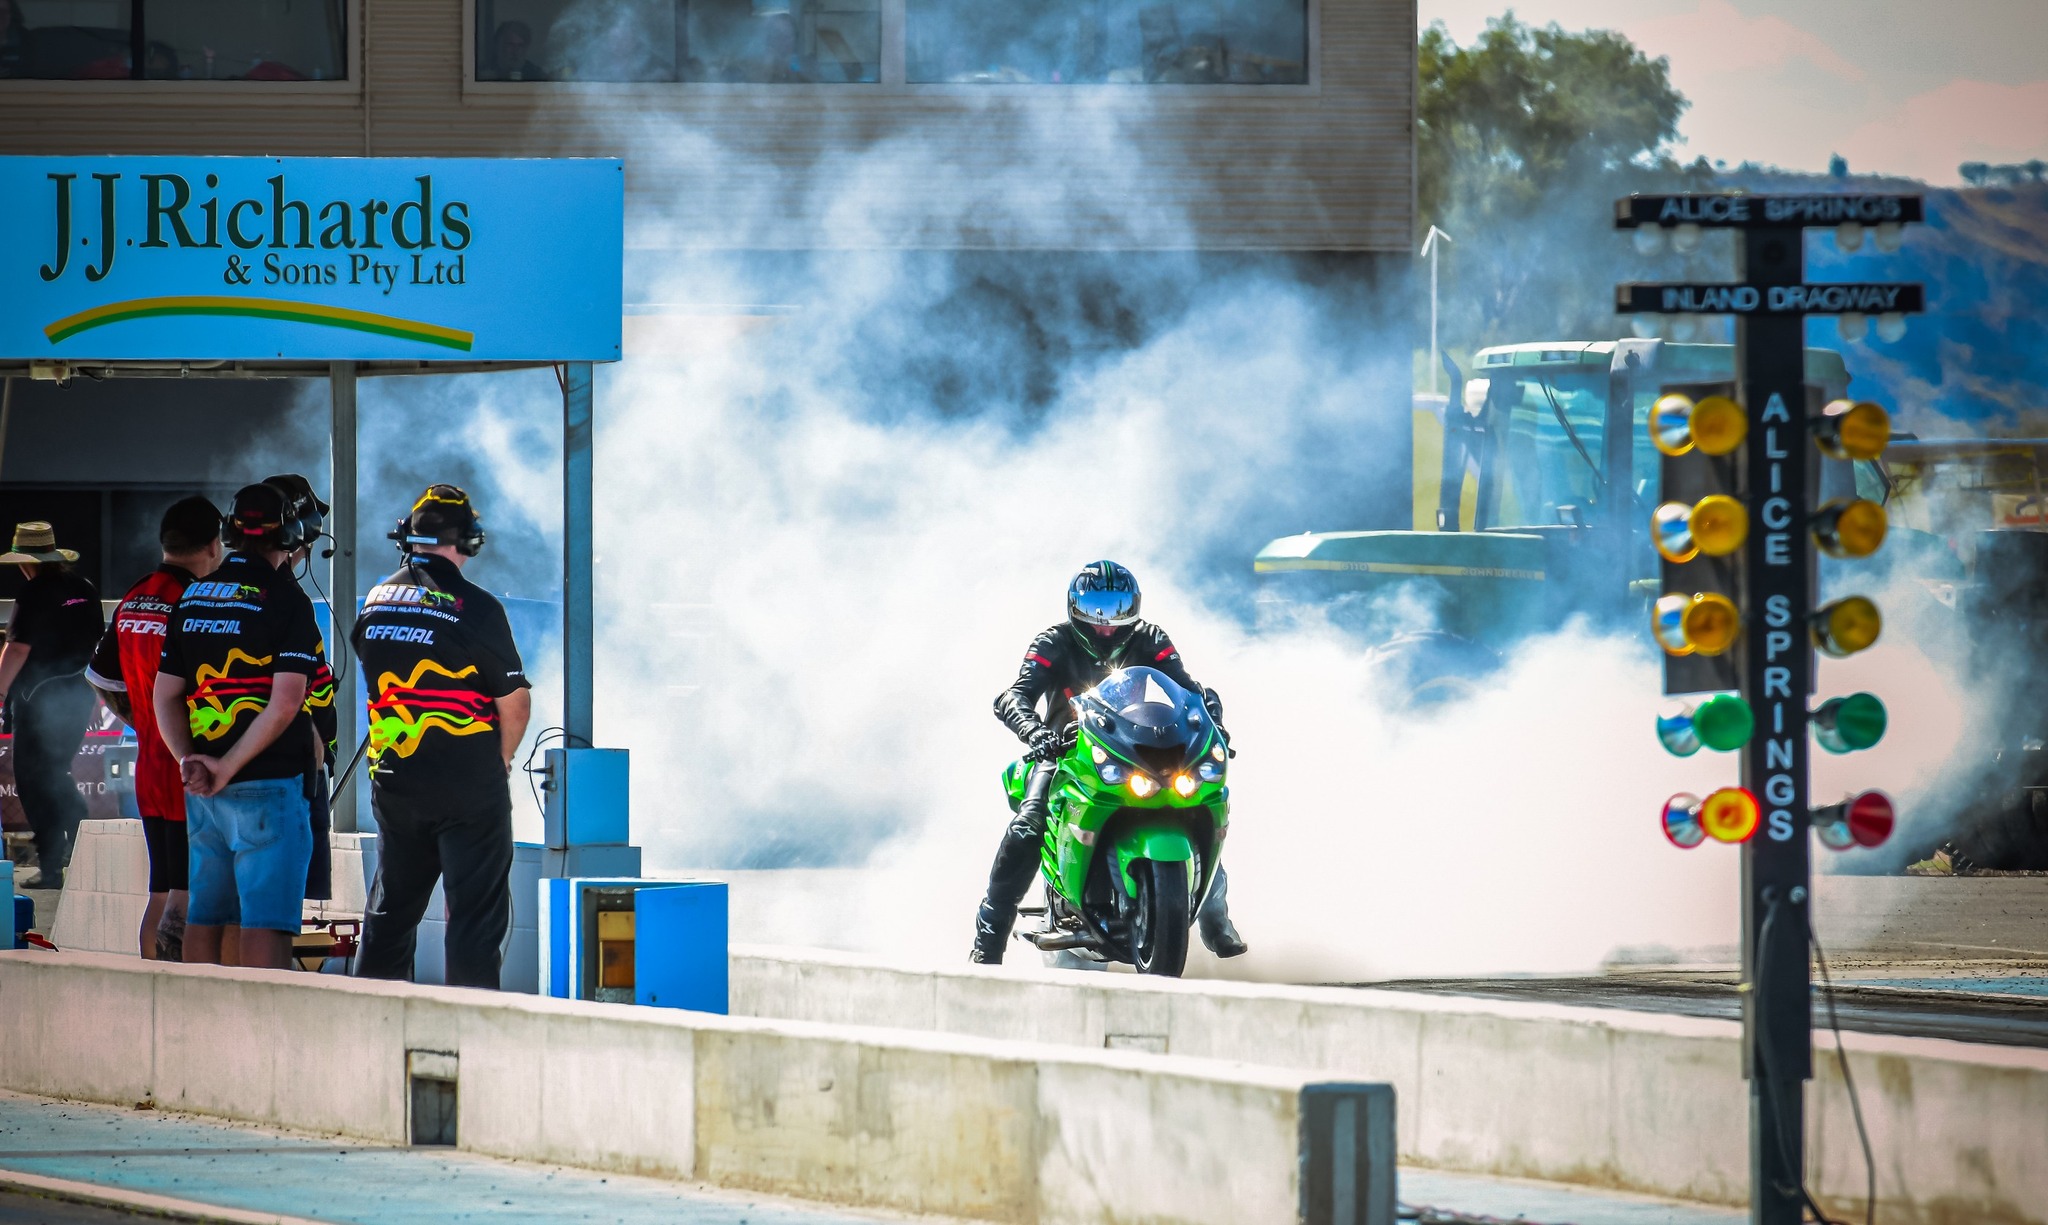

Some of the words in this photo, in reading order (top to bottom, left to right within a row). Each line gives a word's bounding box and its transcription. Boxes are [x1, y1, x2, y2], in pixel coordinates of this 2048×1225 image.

[1659, 194, 1752, 222] ALICE
[1764, 195, 1902, 222] SPRINGS
[223, 255, 251, 284] &
[263, 254, 337, 285] Sons
[348, 254, 400, 294] Pty
[409, 254, 466, 285] Ltd
[1662, 287, 1760, 312] INLAND
[1767, 287, 1901, 312] DRAGWAY
[1761, 392, 1792, 566] ALICE
[182, 618, 241, 635] OFFICIAL
[365, 625, 435, 646] OFFICIAL
[1763, 594, 1796, 843] SPRINGS
